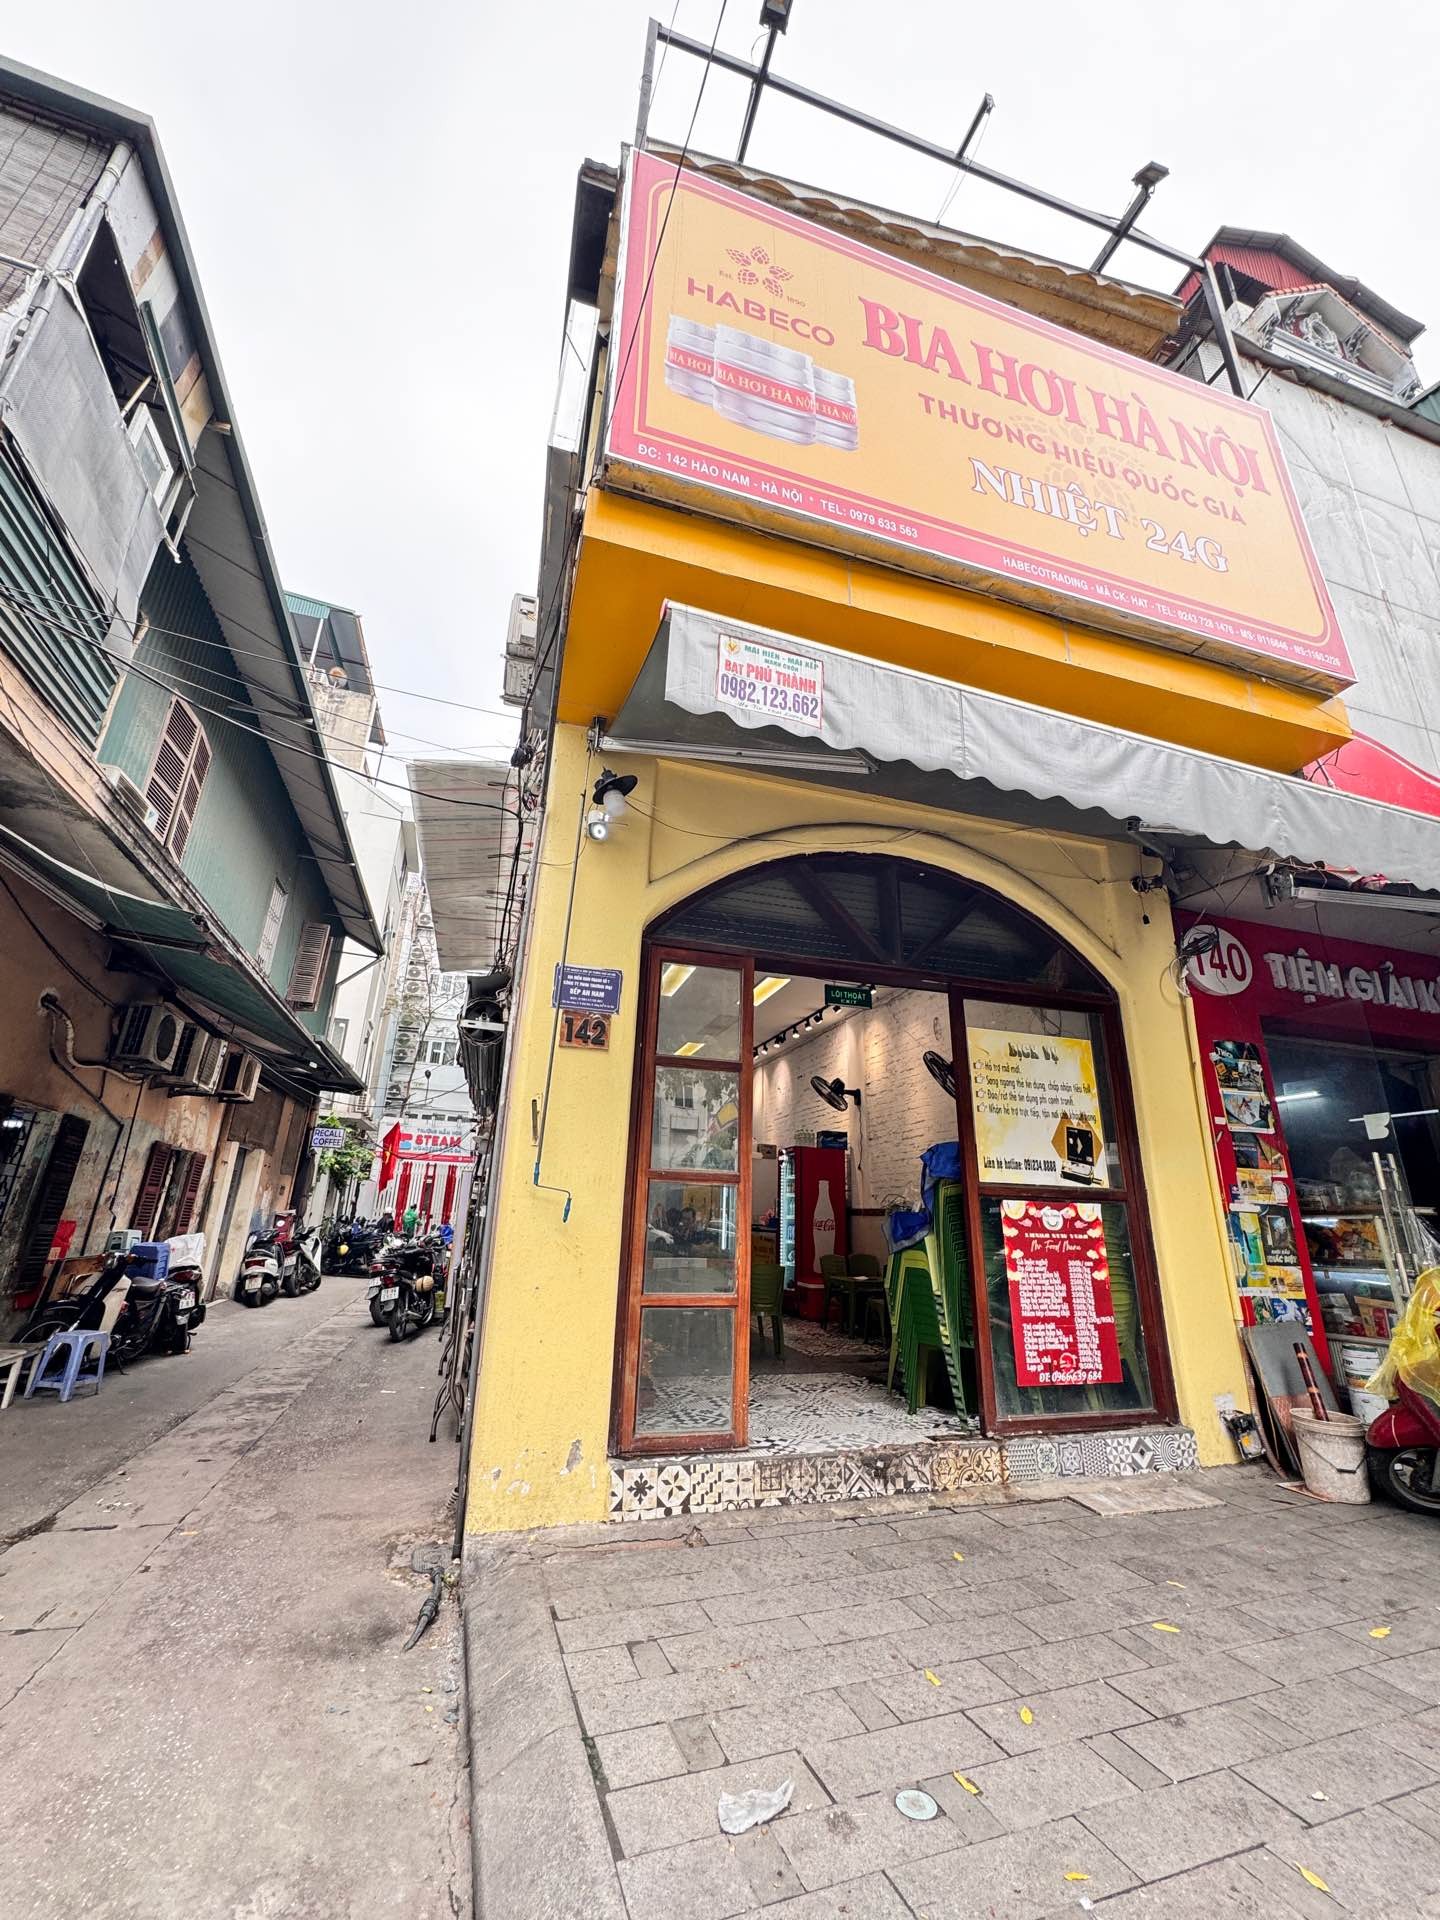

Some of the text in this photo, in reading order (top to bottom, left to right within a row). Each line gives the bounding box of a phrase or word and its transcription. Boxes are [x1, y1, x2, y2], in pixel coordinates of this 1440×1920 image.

[687, 277, 835, 346] HABECO
[716, 366, 735, 383] BIA
[857, 295, 1271, 498] BIA HƠI HÀ NỘI
[918, 393, 1247, 525] THƯƠNG HIỆU QUỐC GIA
[638, 443, 919, 539] ĐC: 142 HÀO NAM HÀ NỘI TEL: 0979 633 563
[968, 456, 1230, 574] NHIỆT 24G
[1003, 556, 1089, 590] HABECOTRADING
[720, 673, 819, 719] 0982.123.662
[724, 659, 745, 676] BẠT
[776, 670, 817, 695] THÀNH
[1195, 941, 1246, 982] 140
[1263, 948, 1346, 1004] TIỆM
[1414, 976, 1440, 1014] K
[565, 1016, 607, 1046] 142
[313, 1137, 342, 1146] COFFEE
[314, 1128, 342, 1138] RECALL
[415, 1134, 462, 1147] STEAM
